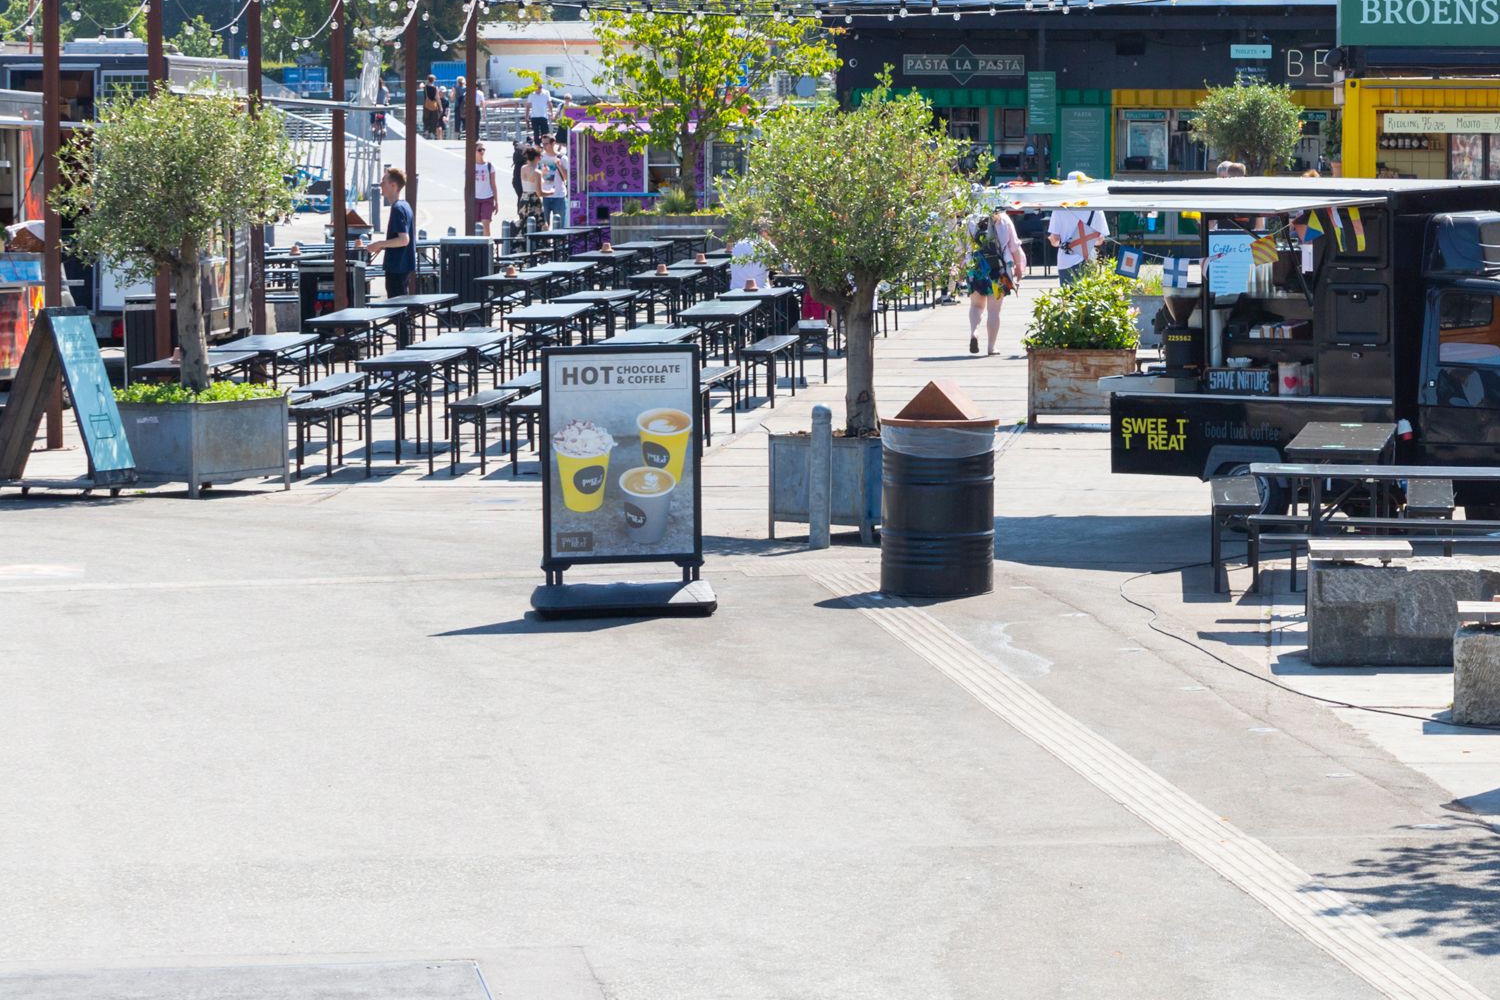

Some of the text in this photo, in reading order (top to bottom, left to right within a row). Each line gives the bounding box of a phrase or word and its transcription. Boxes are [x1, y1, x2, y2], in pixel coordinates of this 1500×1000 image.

[907, 59, 1021, 70] PASTA LA PASTA
[616, 364, 680, 375] CHOCOLATE
[562, 366, 614, 386] HOT
[616, 375, 666, 384] & COFFEE
[1209, 370, 1271, 392] SAVE NATURE
